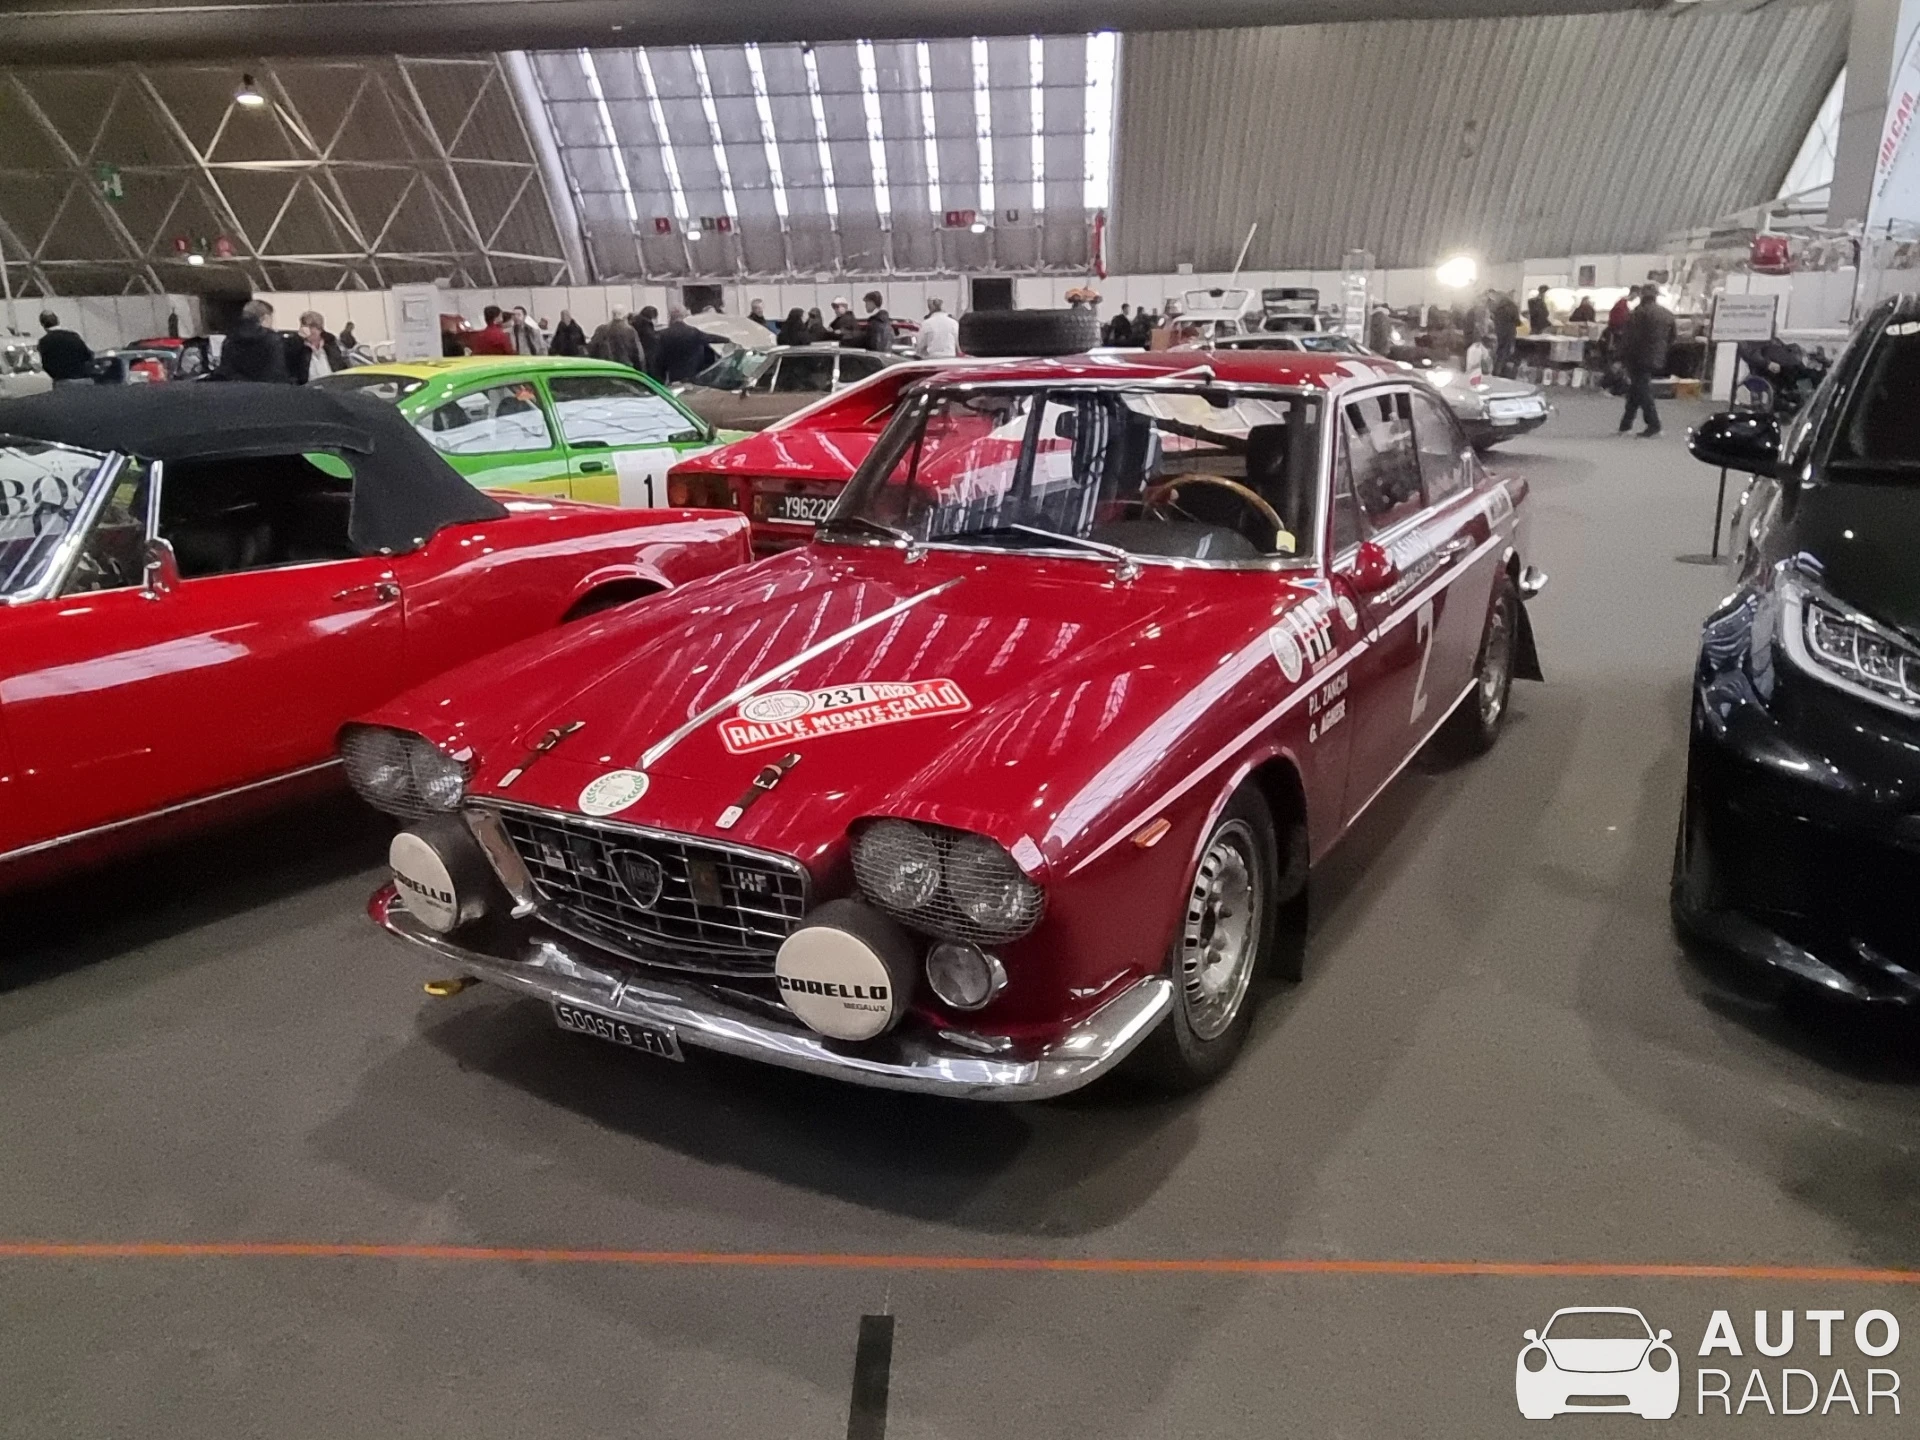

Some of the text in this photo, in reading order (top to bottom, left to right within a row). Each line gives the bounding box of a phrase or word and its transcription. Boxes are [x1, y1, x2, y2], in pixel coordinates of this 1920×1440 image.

[818, 687, 867, 708] 237
[873, 684, 917, 700] 2020
[728, 719, 806, 747] RALLYE
[811, 685, 961, 728] MONTE-CARLO
[738, 871, 767, 893] HF
[777, 975, 888, 1000] CARELLO
